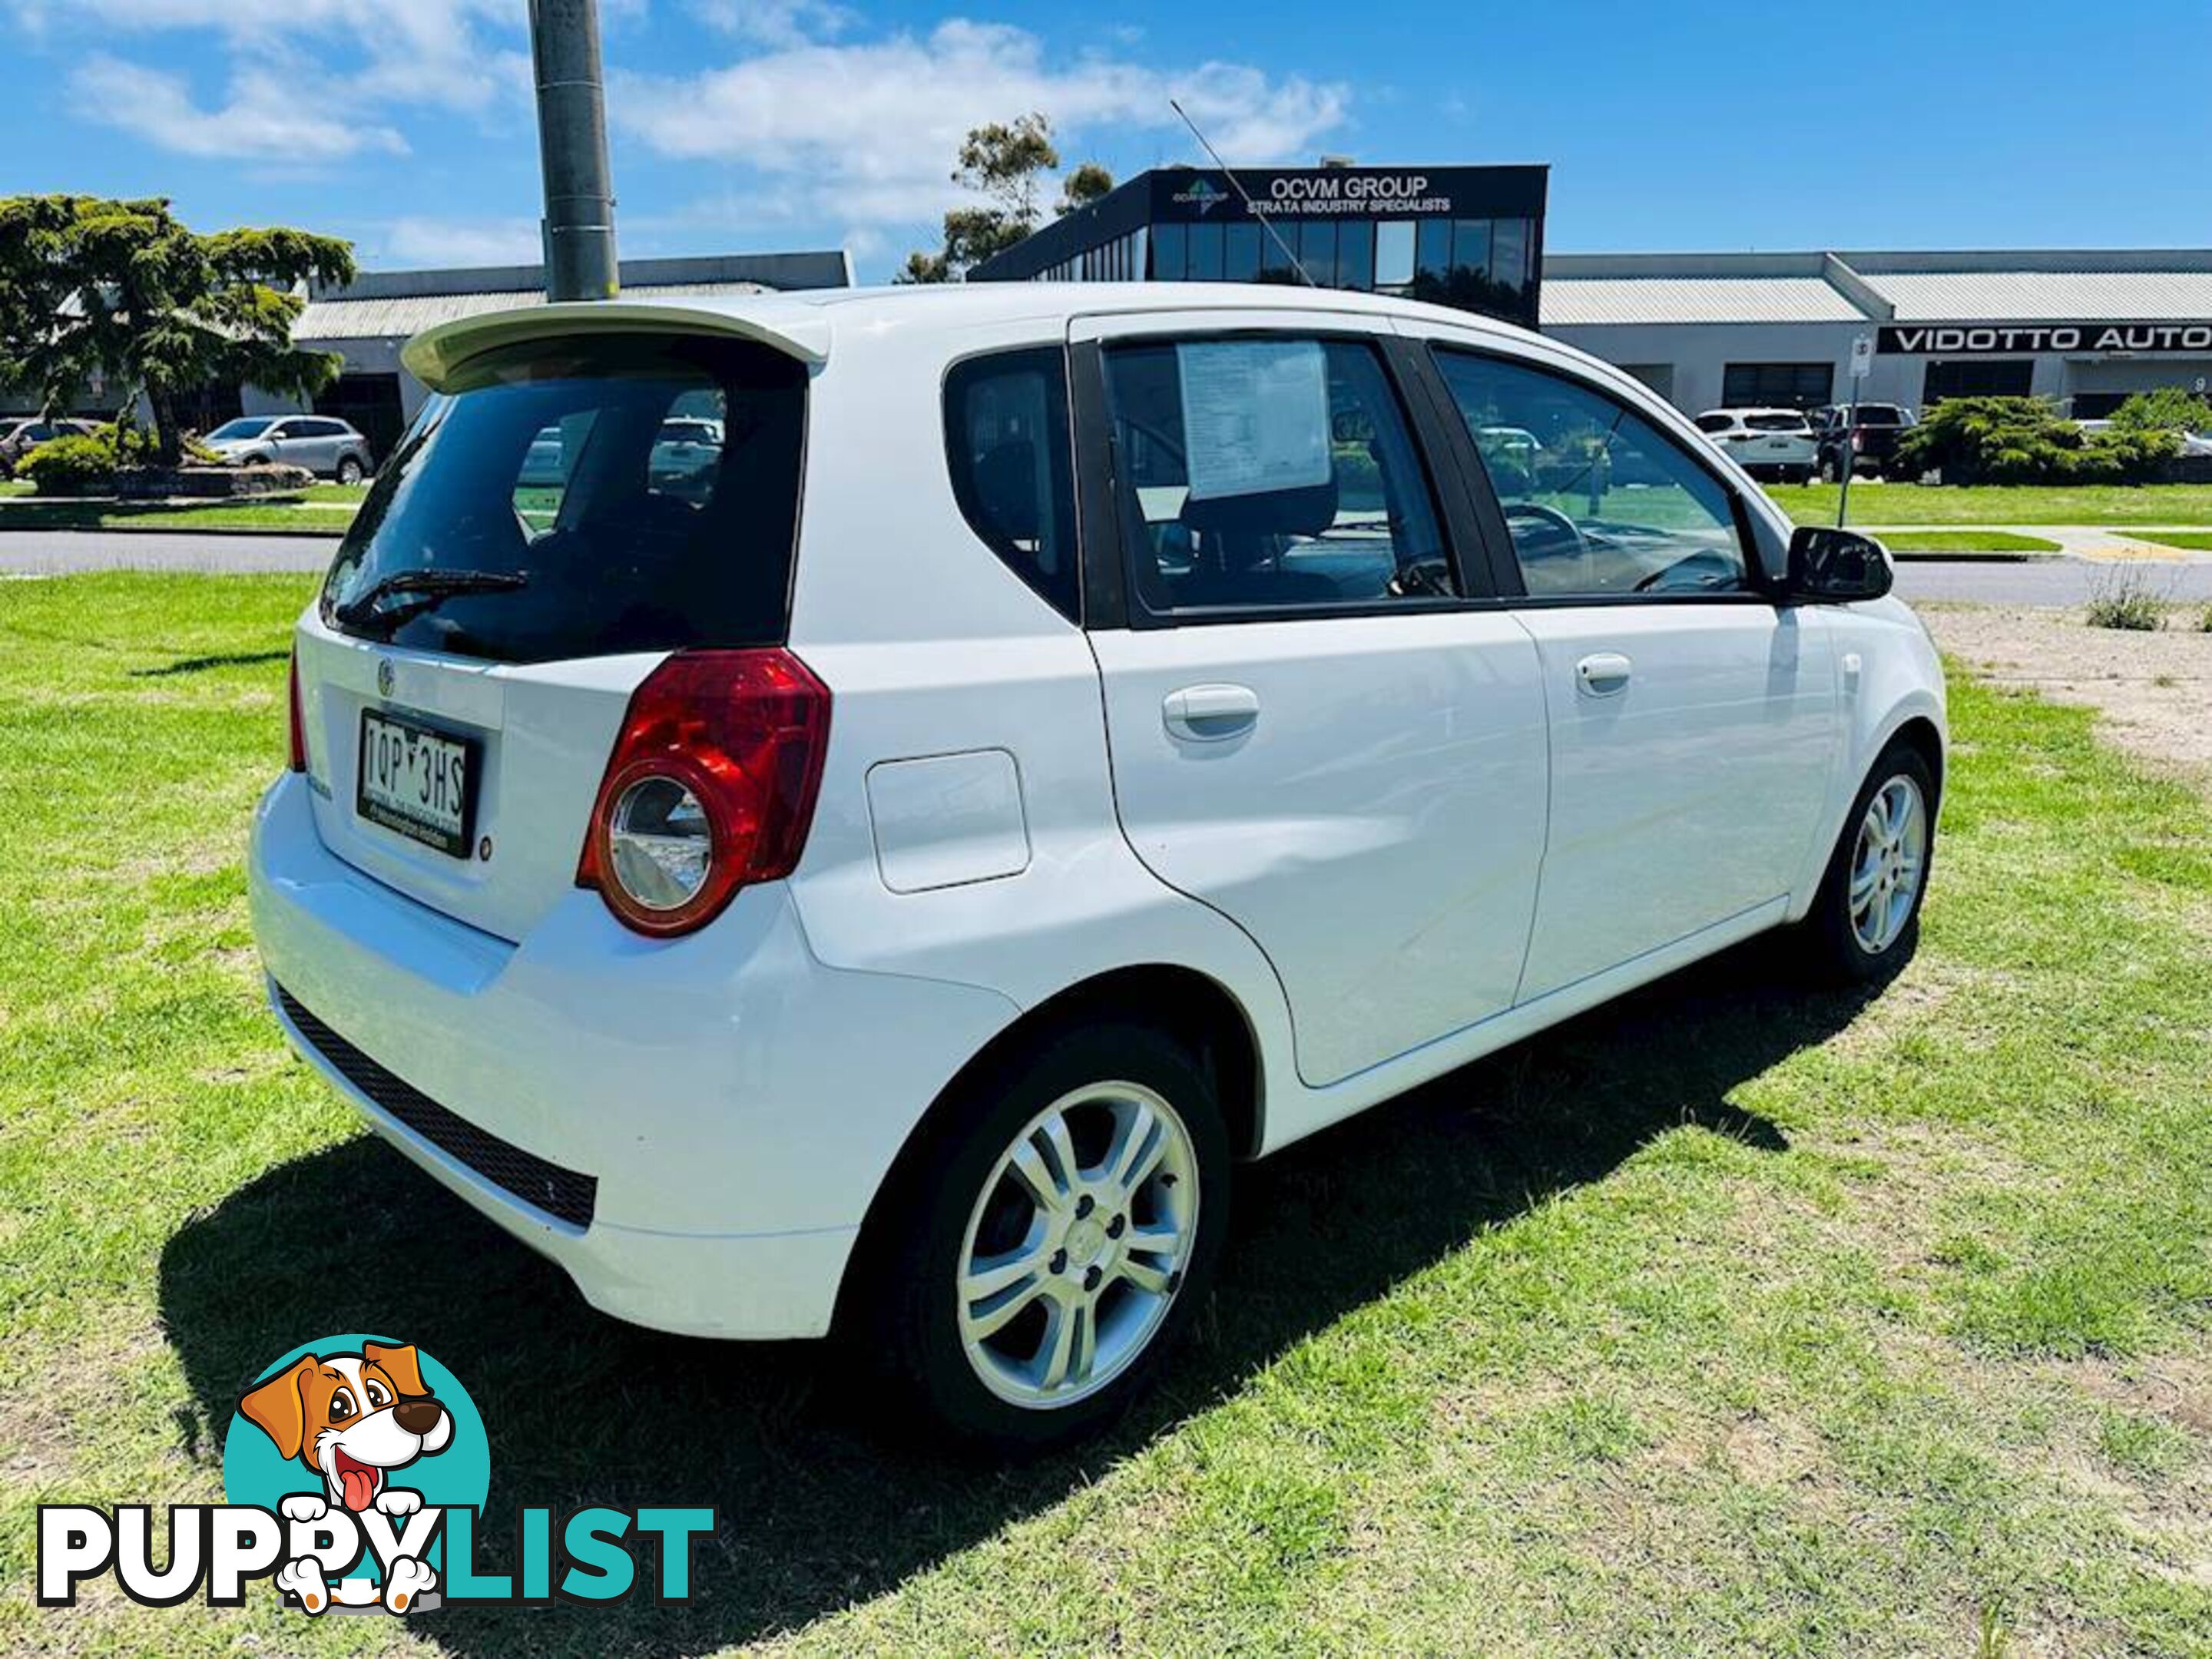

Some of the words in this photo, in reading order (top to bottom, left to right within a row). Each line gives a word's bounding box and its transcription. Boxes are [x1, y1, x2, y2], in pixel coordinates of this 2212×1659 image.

[1271, 178, 1339, 199] OCVM
[1344, 177, 1427, 198] GROUP
[1247, 200, 1300, 214] STRATA
[1302, 200, 1366, 213] INDUSTRY
[1369, 198, 1450, 212] SPECIALISTS
[1896, 329, 2081, 350] VIDOTTO
[2094, 327, 2211, 349] AUTO
